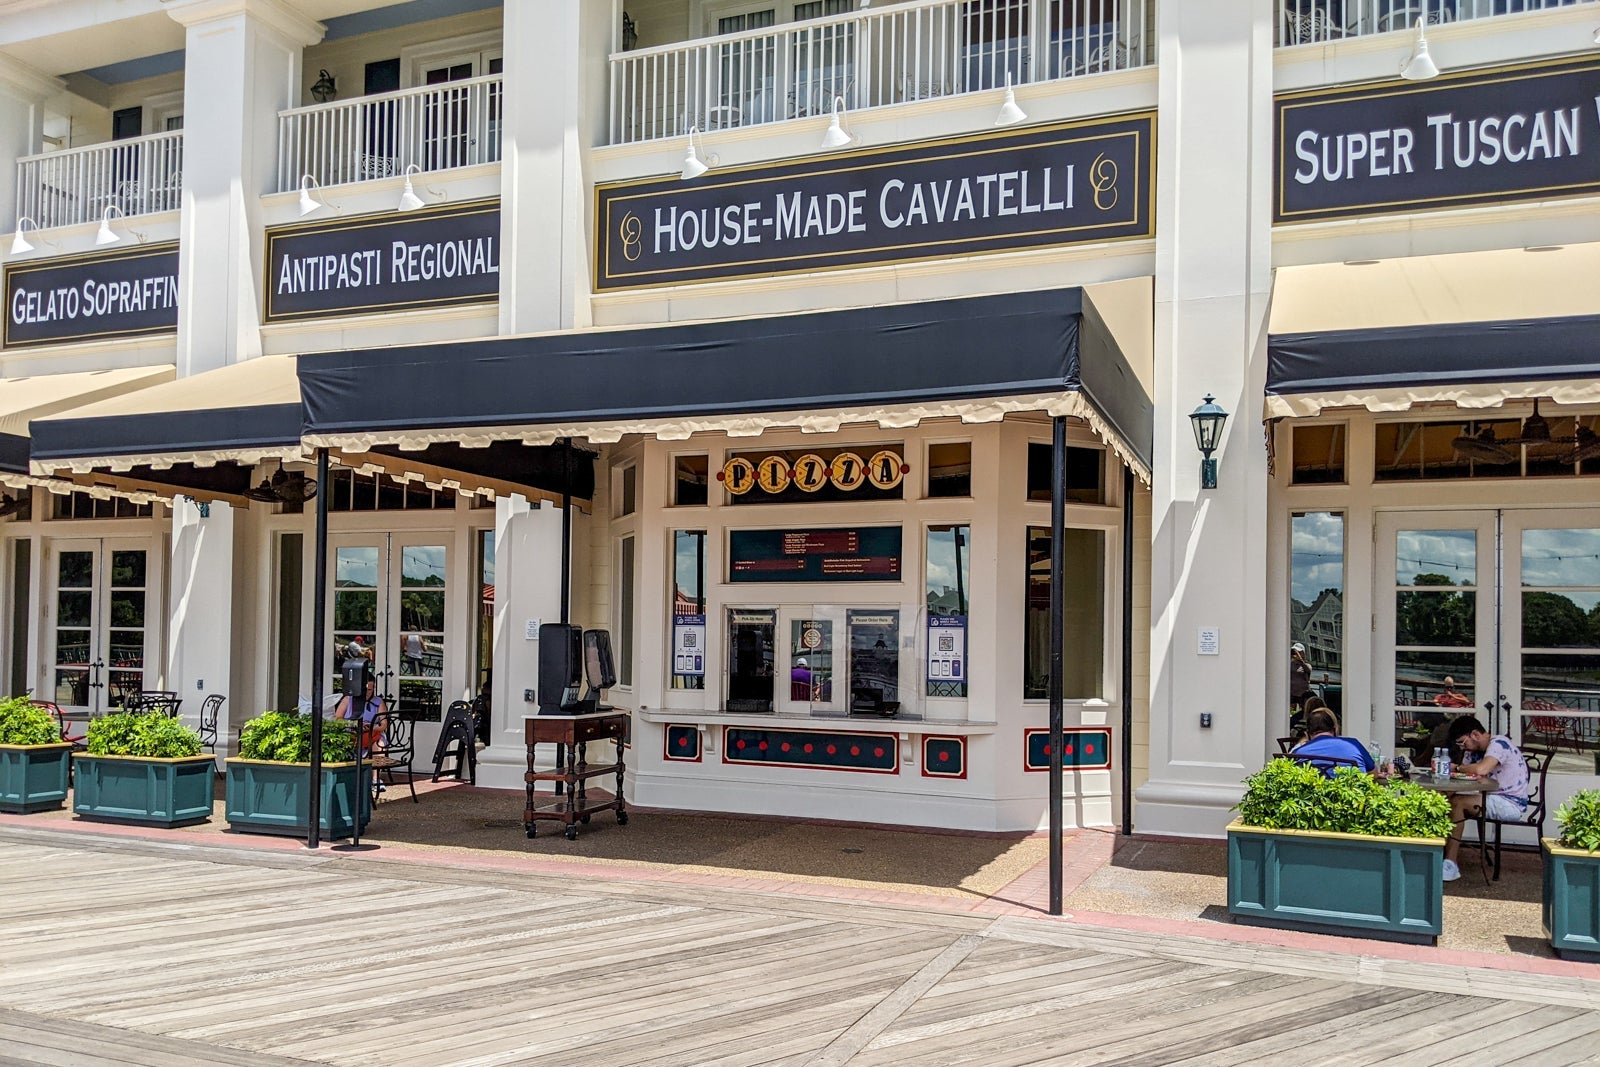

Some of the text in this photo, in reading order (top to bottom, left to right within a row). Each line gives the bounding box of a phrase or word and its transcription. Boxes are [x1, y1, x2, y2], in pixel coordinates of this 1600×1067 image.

[1294, 128, 1414, 184] SUPER
[1426, 106, 1580, 171] TUSCAN
[654, 164, 1074, 254] HOUSE-MADE CAVATELLI
[277, 236, 499, 295] ANTIPASTI REGIONAL
[12, 287, 79, 325] GELATO
[732, 457, 893, 489] PIZZA
